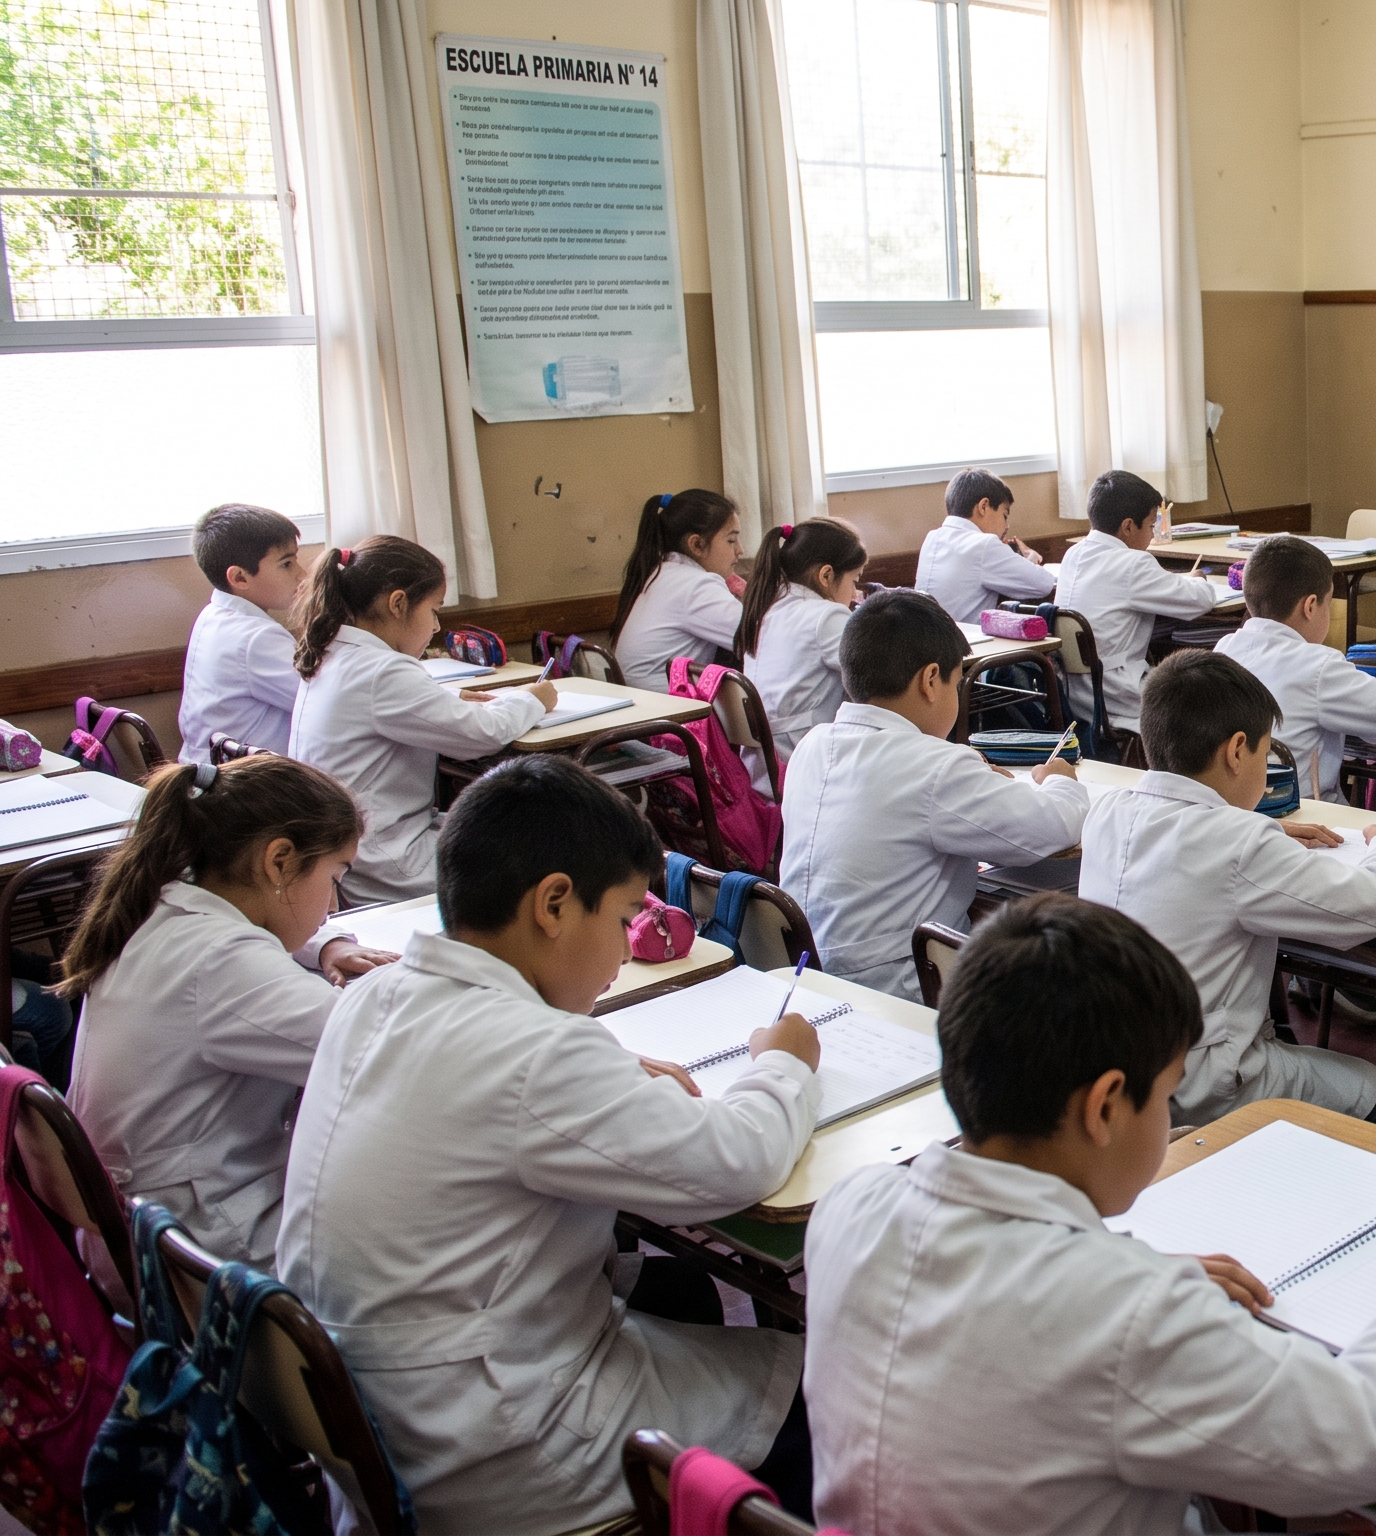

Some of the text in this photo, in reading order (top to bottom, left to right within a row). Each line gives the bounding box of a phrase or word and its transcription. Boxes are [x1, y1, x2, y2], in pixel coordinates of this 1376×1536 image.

[446, 47, 529, 77] ESCUELA
[532, 55, 615, 85] PRIMARIA
[639, 65, 659, 88] 14
